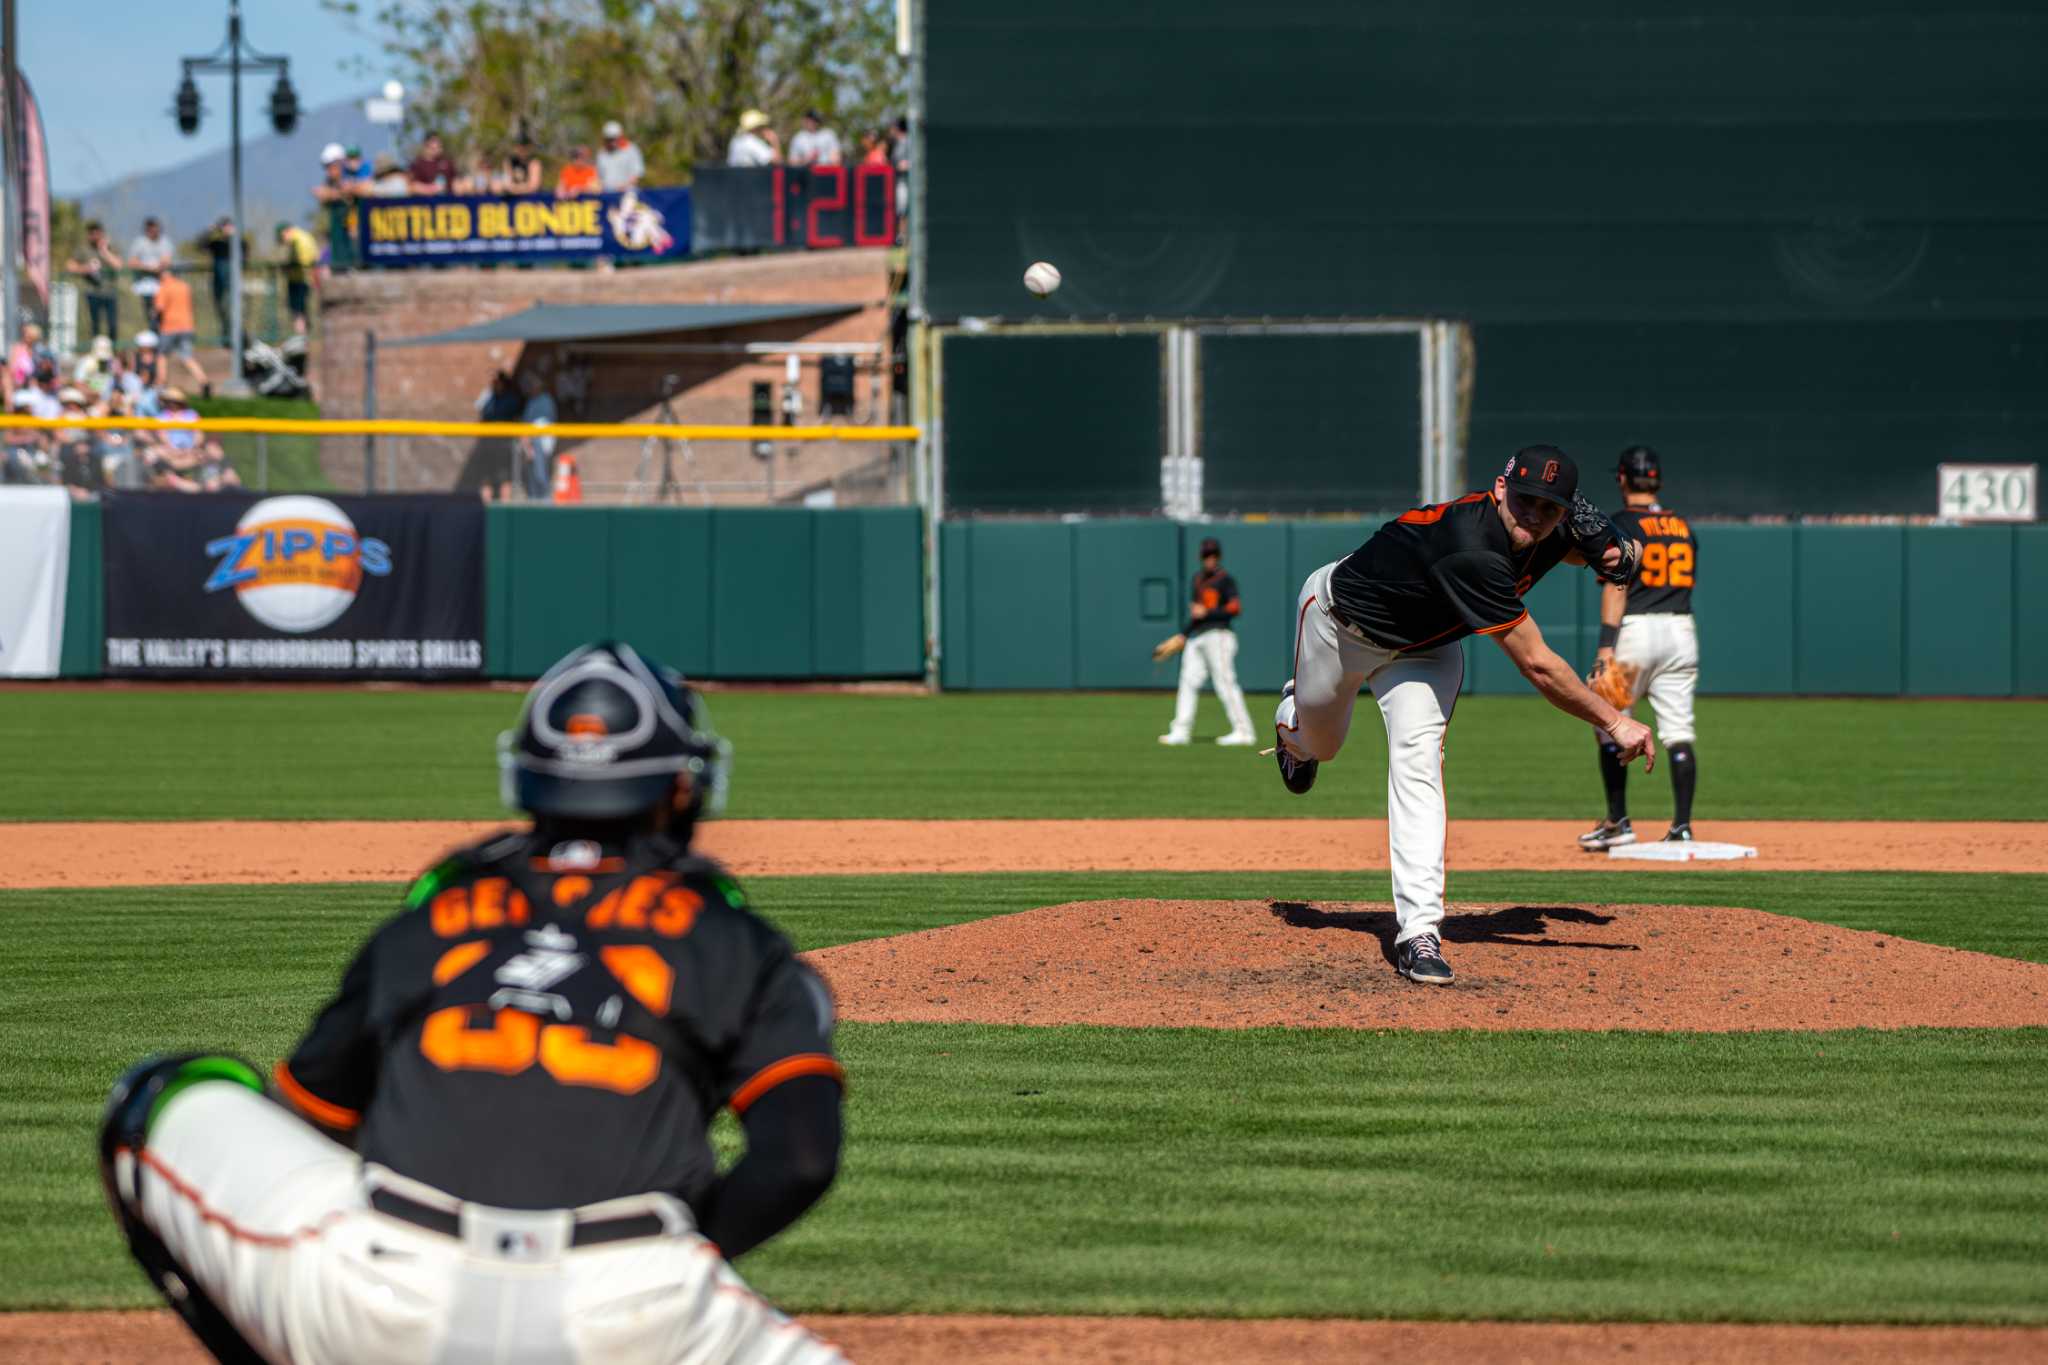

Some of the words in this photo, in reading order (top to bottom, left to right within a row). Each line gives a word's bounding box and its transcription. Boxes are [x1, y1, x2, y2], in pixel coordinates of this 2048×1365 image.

[477, 199, 601, 238] BLONDE
[772, 163, 896, 246] 1:20
[1943, 470, 2028, 515] 430
[204, 528, 393, 593] ZIPPS
[1641, 542, 1695, 588] 92
[106, 638, 142, 668] THE
[143, 638, 225, 668] VALLEY'S
[355, 640, 419, 668] SPORTS
